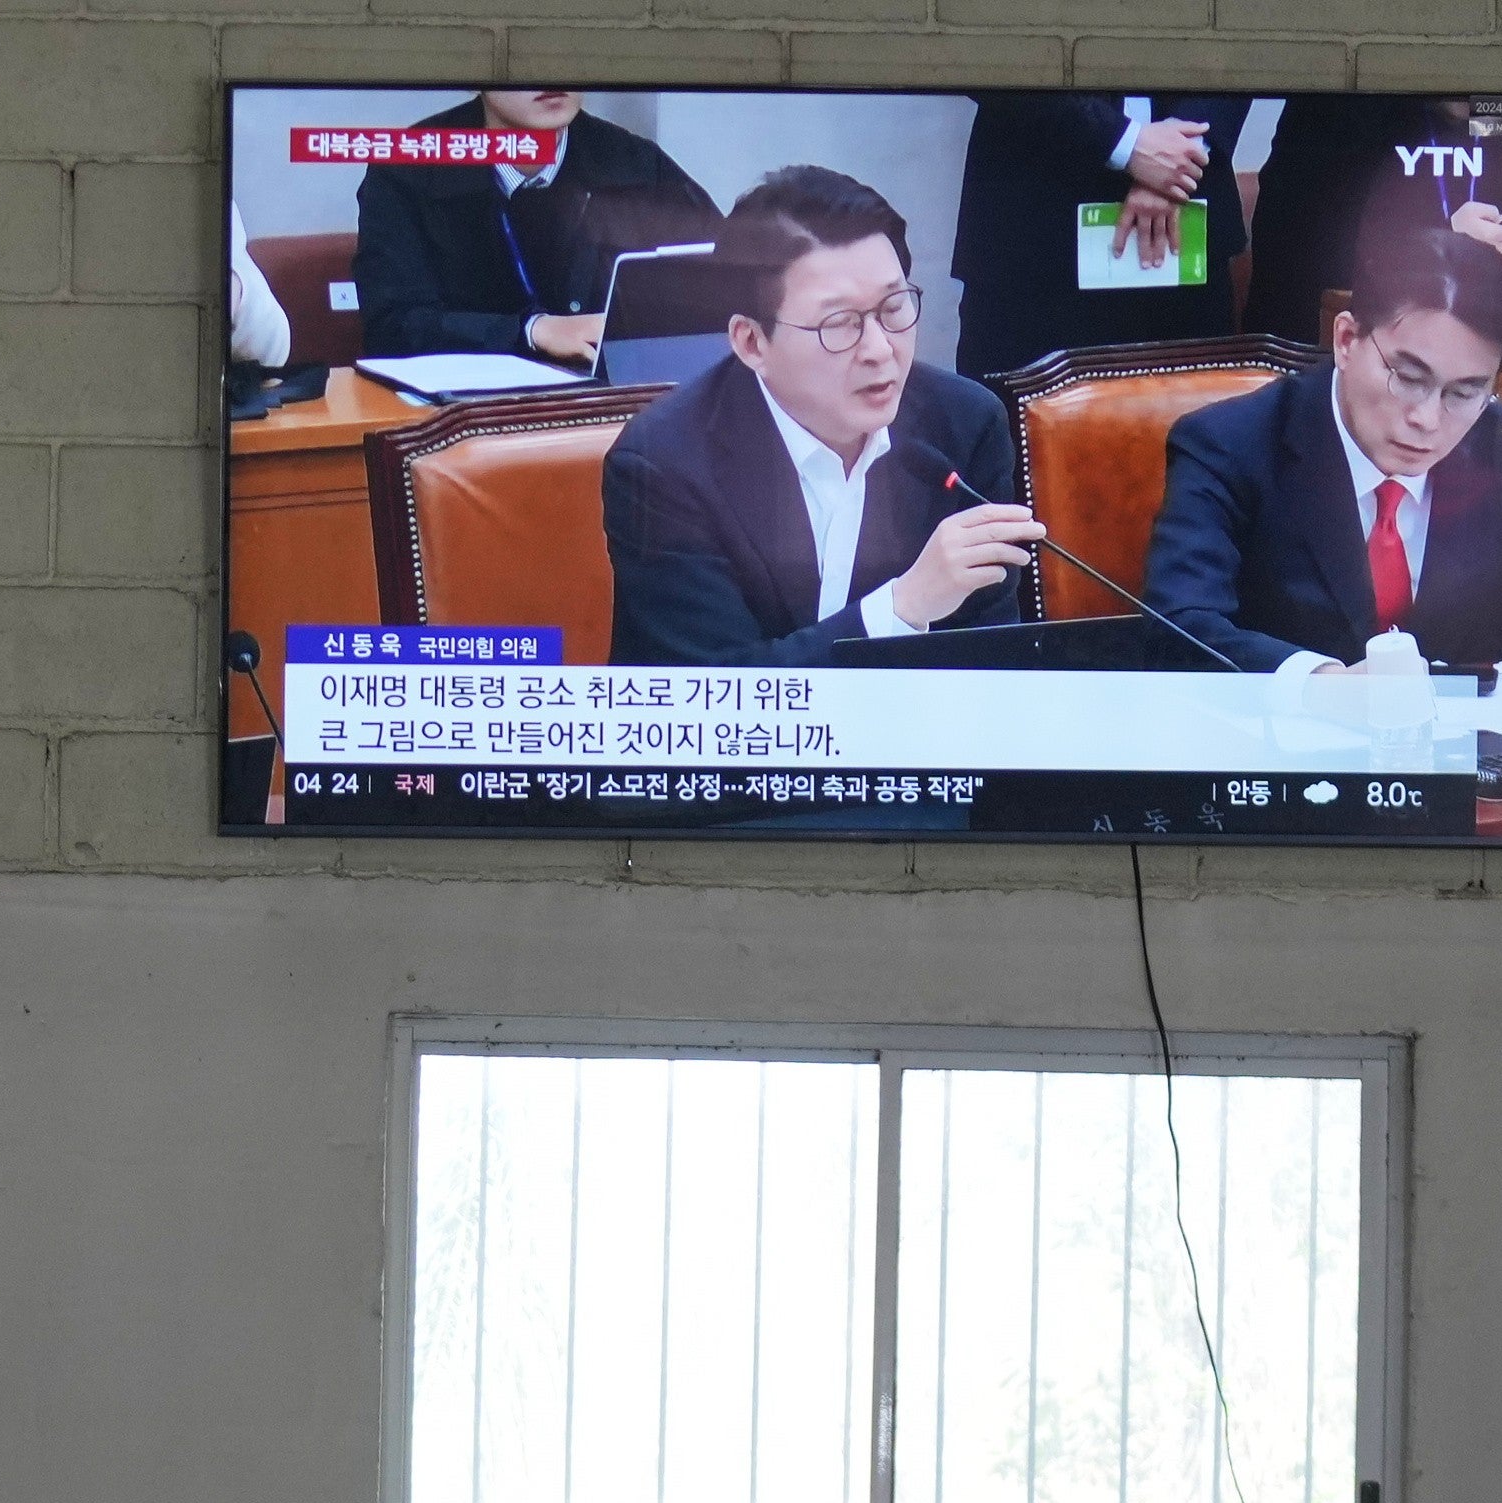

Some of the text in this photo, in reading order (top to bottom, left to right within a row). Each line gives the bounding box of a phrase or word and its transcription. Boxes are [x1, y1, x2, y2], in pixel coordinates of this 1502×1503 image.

[1476, 102, 1502, 113] 2024
[307, 132, 540, 159] 대북송금 녹취 공방 계속
[1395, 146, 1483, 176] YTN
[418, 636, 494, 659] 국민의힘
[499, 637, 538, 659] 의원
[321, 675, 813, 711] 이재명 대통령 공소 취소로 가기 위한
[319, 720, 840, 757] 큰 그림으로 만들어진 것이지 않습니까.
[294, 773, 435, 795] 04 24 국제
[460, 771, 531, 799] 이란군
[536, 772, 592, 800] "장기
[598, 772, 668, 800] 소모전
[821, 775, 870, 802] 축과
[873, 776, 922, 803] 공동
[927, 776, 984, 803] 작전"
[1227, 779, 1272, 806] 안동
